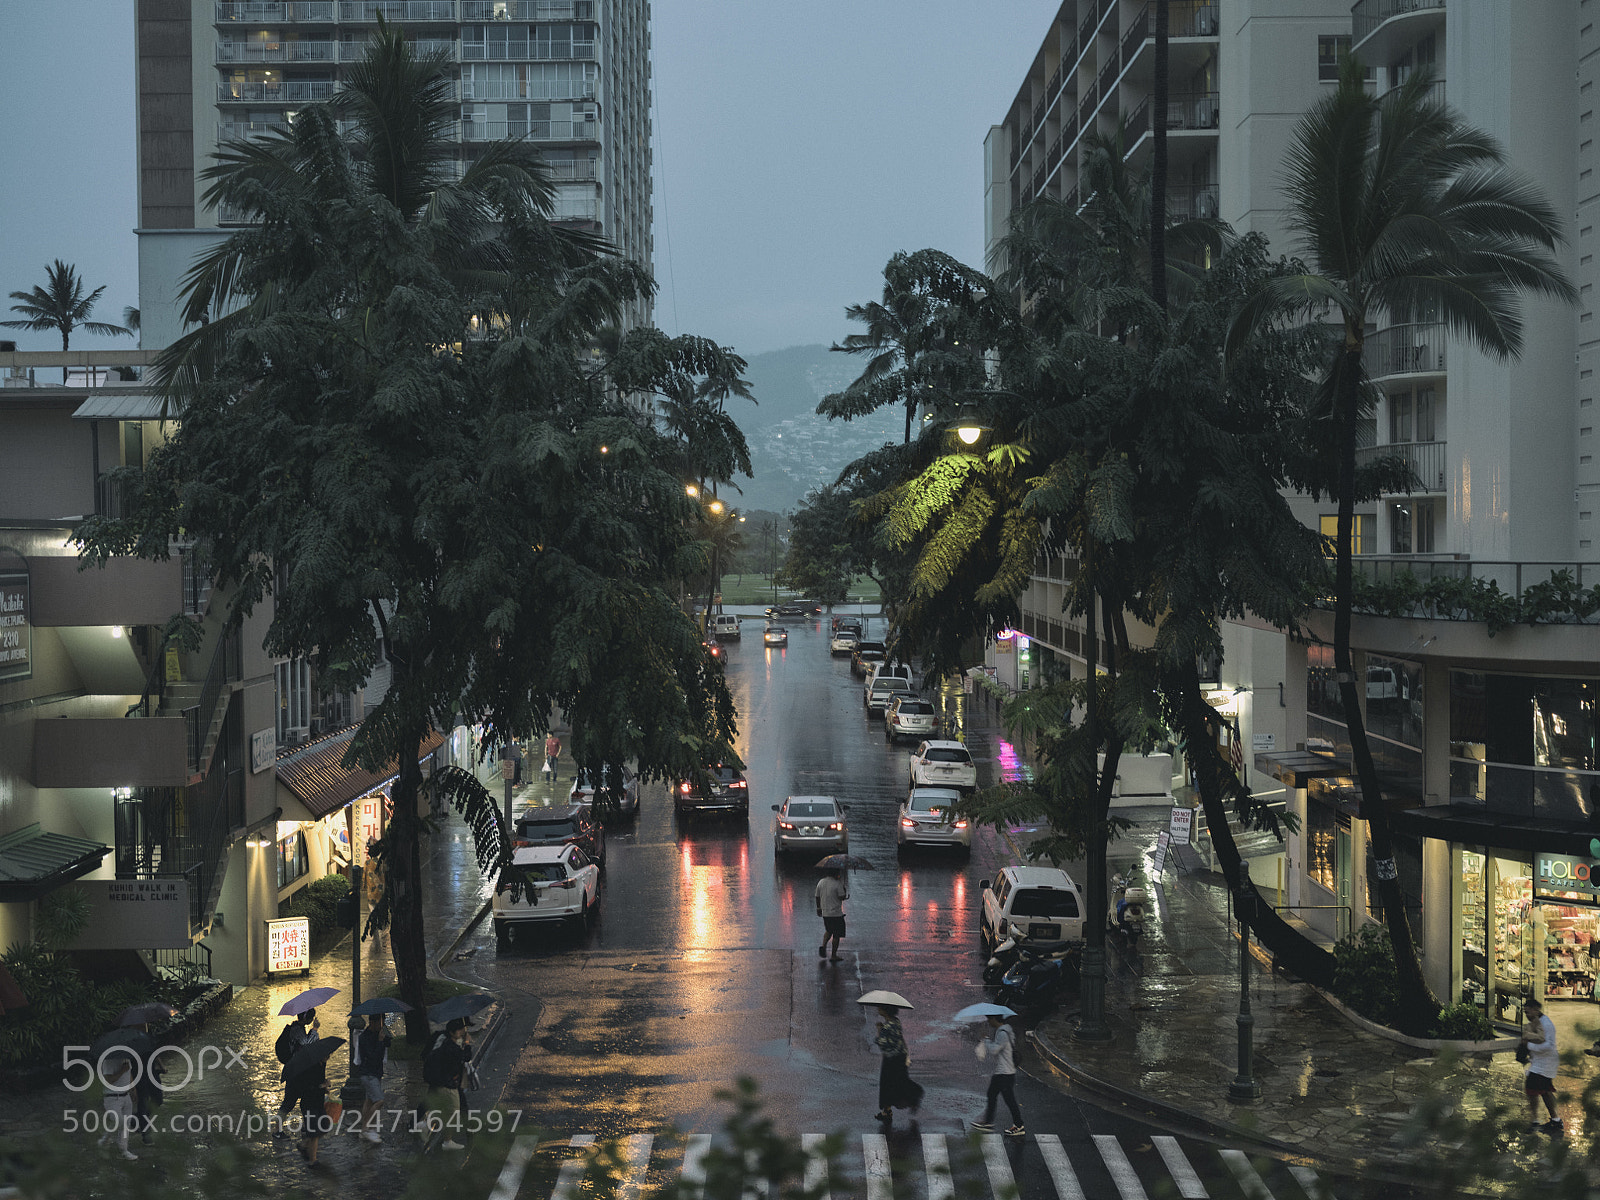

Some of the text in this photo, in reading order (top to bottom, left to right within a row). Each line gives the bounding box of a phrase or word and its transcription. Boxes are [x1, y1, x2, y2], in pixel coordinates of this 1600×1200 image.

[3, 631, 19, 648] 2310
[1540, 859, 1594, 881] HOLO
[138, 884, 161, 892] WALK
[109, 893, 178, 901] MEDICAL CLINIC
